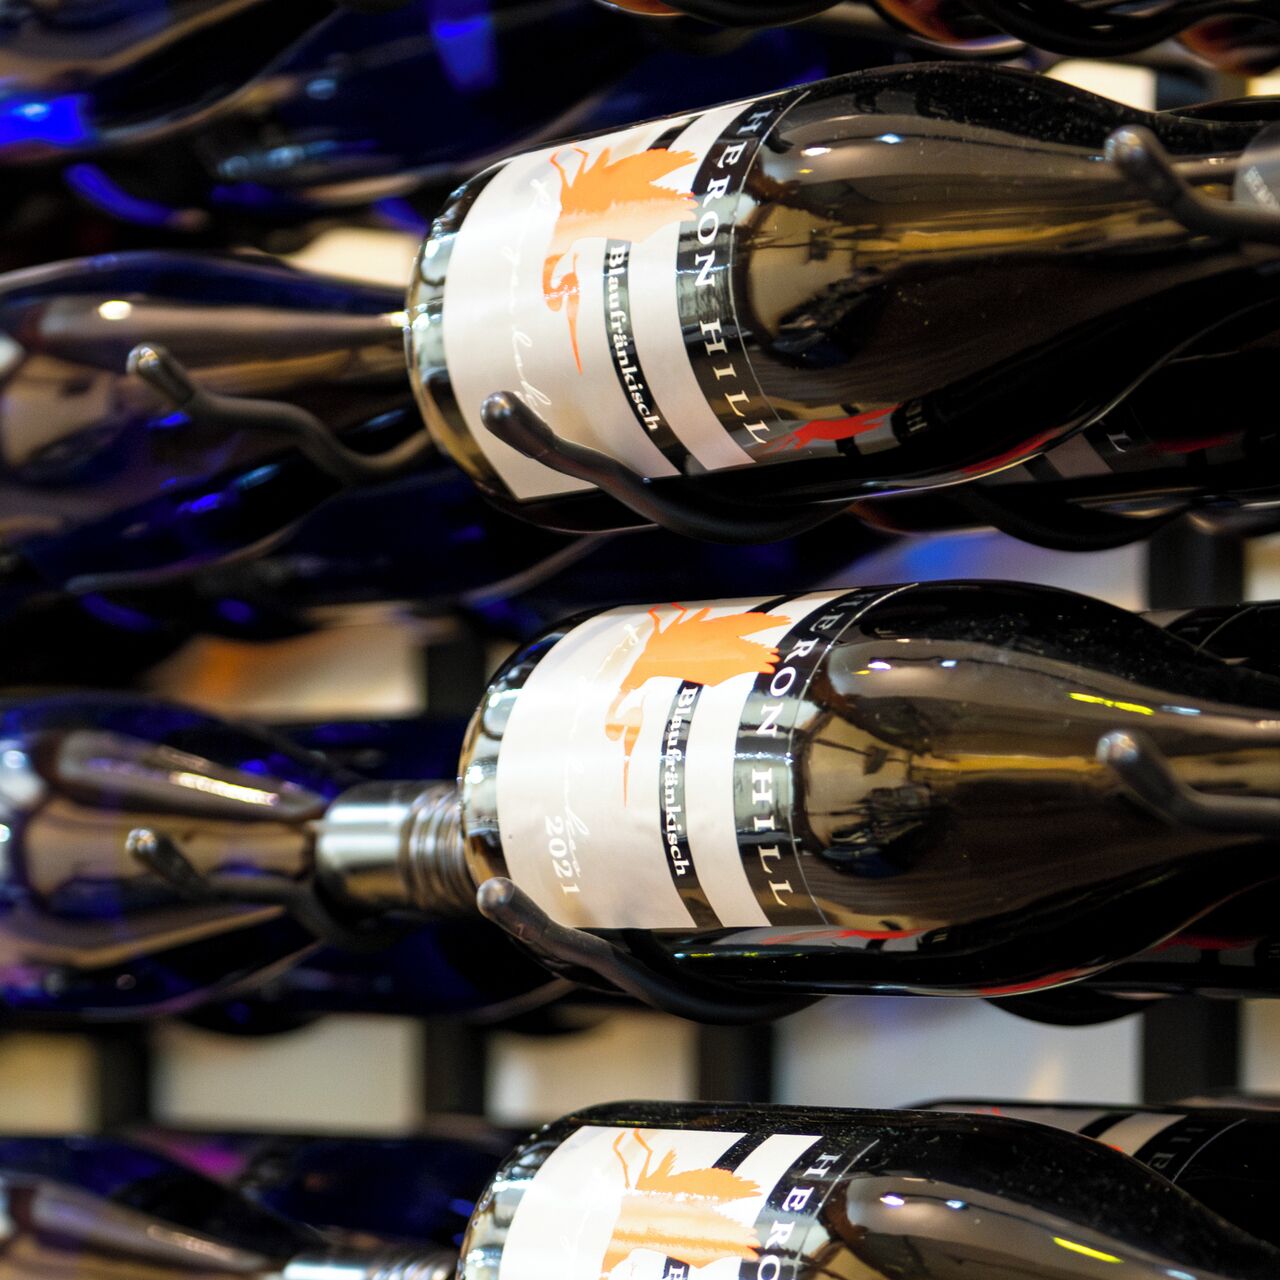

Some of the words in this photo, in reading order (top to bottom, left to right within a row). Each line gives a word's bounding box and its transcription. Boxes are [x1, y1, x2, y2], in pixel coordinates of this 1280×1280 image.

[695, 108, 776, 289] HERON
[606, 245, 659, 432] Blaufränkisch
[698, 319, 769, 445] HILL
[755, 592, 876, 739] HERON
[545, 814, 582, 896] 2021
[663, 686, 699, 878] Blaufränkisch
[751, 767, 795, 908] HILL
